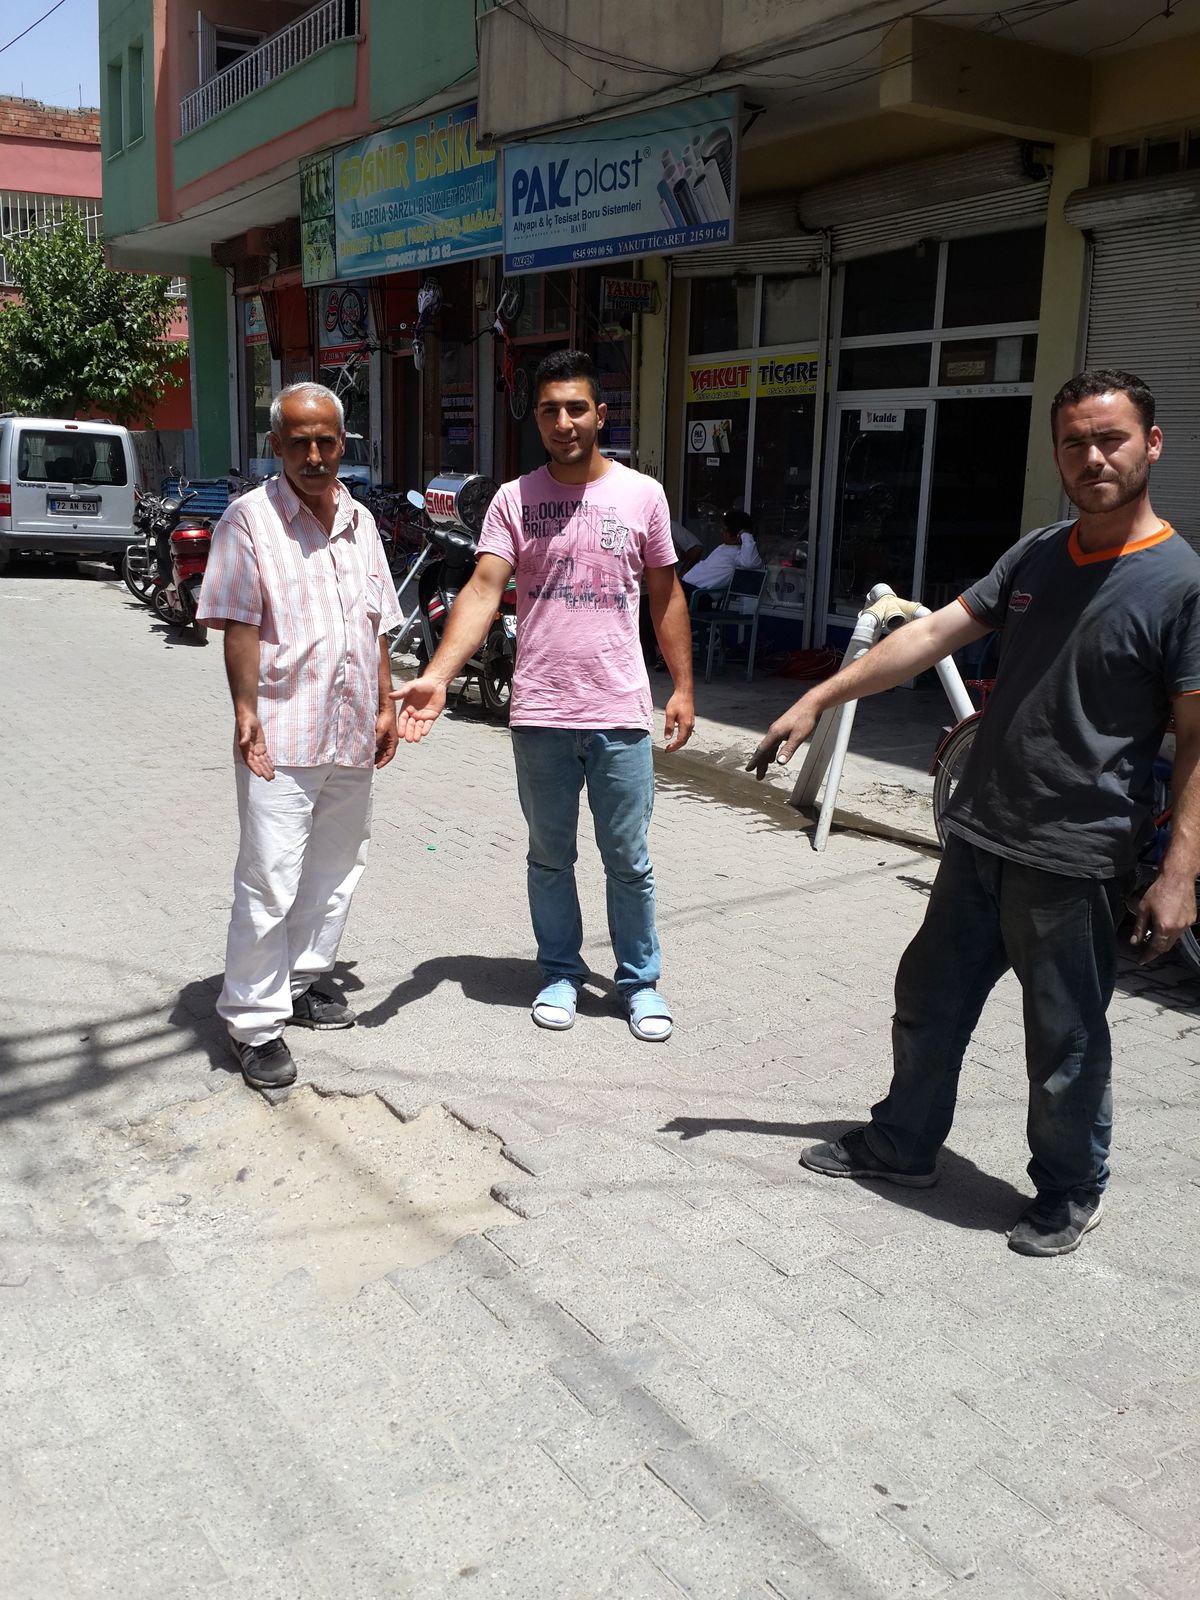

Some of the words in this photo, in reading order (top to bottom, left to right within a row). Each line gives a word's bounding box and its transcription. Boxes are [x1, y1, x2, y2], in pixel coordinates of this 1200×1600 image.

[415, 114, 496, 182] BİSİKL
[513, 219, 537, 234] Altyapı
[538, 216, 545, 227] &
[554, 210, 580, 224] Tesisat
[581, 207, 600, 220] Boru
[602, 200, 642, 217] Sistemleri
[618, 236, 647, 253] YAKUT
[648, 232, 686, 249] TİCARET
[690, 230, 705, 243] 215
[705, 228, 716, 240] 91
[717, 226, 727, 238] 64
[607, 280, 649, 297] YAKUT
[690, 365, 751, 394] YAKUT
[759, 360, 825, 386] TİCARE
[872, 412, 897, 423] kalde
[57, 501, 66, 510] 72
[70, 502, 79, 510] AN
[82, 502, 97, 511] 621
[522, 500, 588, 522] BROOKLYN
[600, 519, 629, 557] 57
